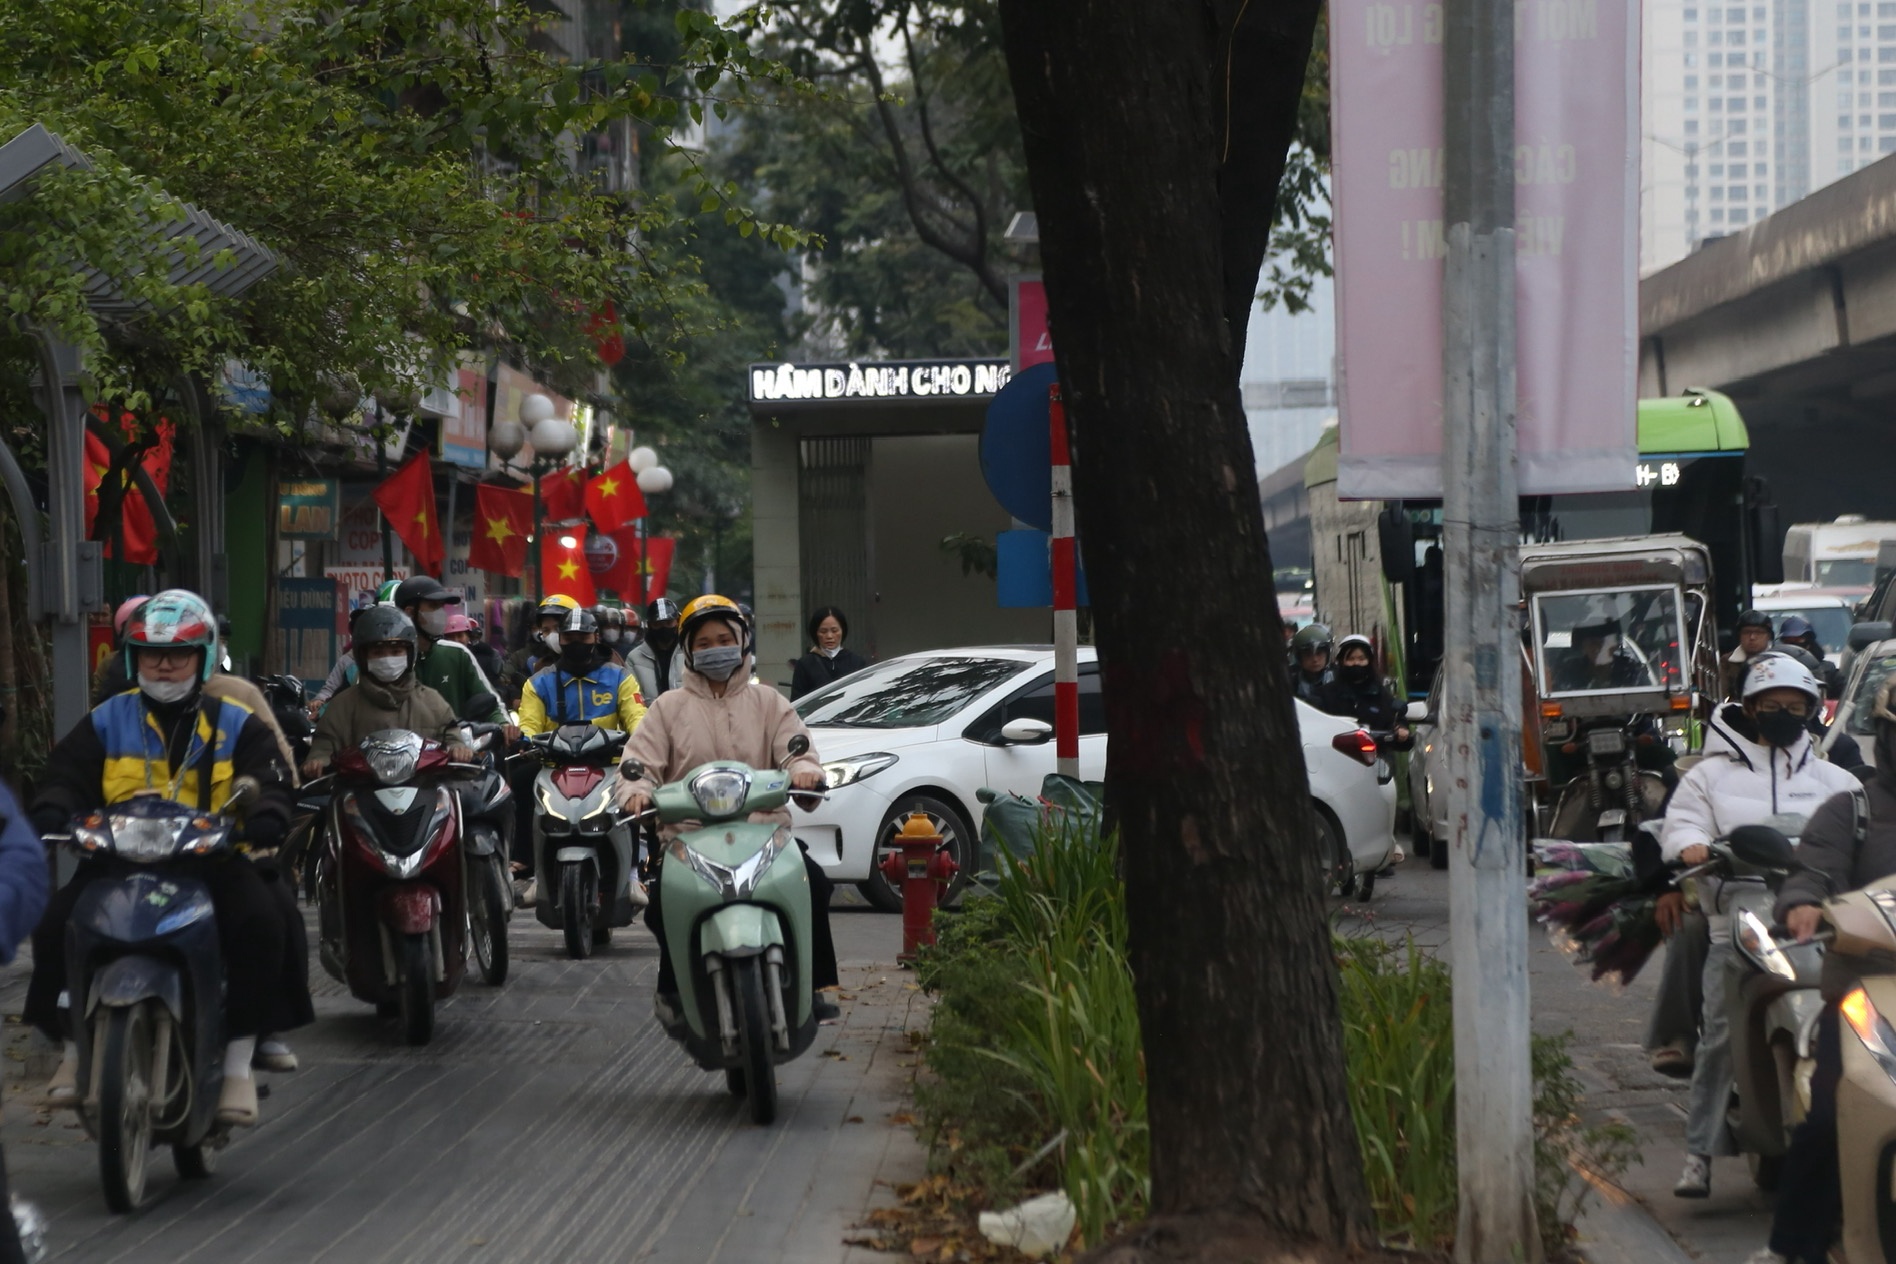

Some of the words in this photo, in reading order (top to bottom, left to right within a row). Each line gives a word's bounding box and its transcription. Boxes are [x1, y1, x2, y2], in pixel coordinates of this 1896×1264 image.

[825, 362, 908, 398] DÀNH
[911, 364, 971, 396] CHO
[591, 689, 613, 706] be
